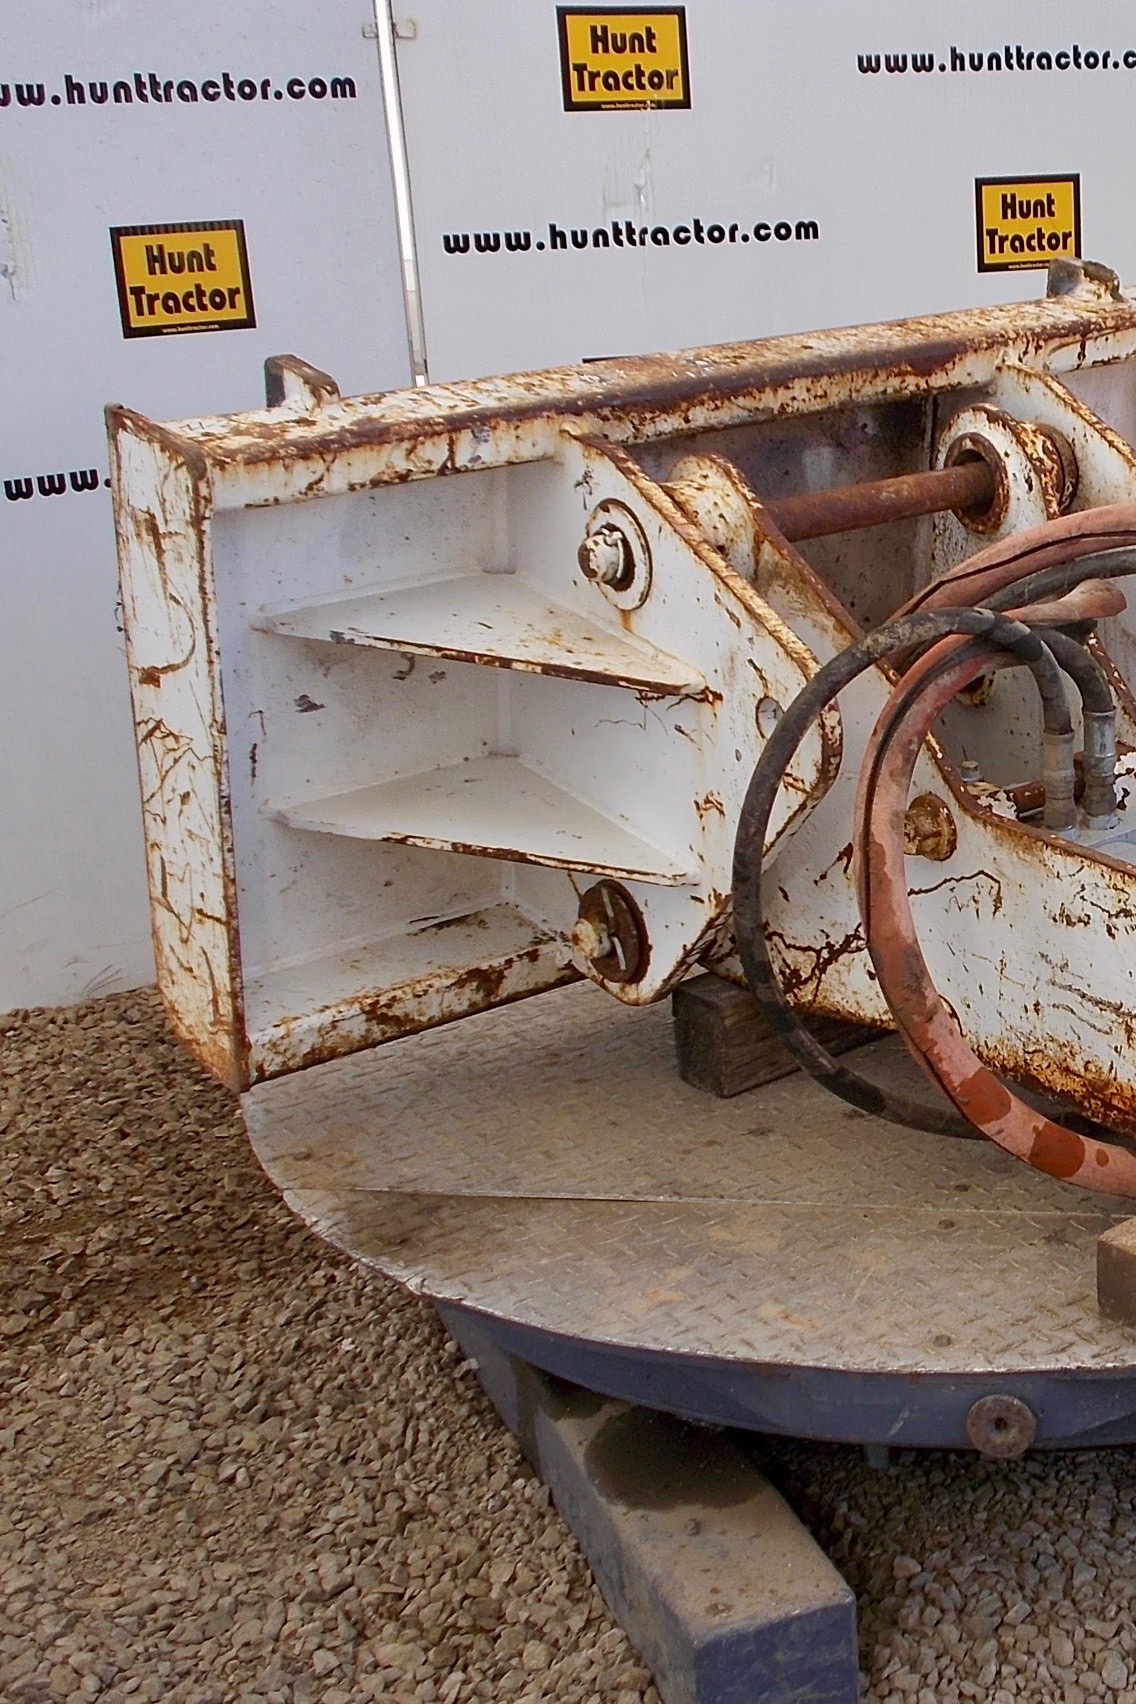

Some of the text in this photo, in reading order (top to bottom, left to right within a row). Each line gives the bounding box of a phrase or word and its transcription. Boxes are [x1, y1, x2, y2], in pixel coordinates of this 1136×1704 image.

[590, 25, 656, 53] Hunt
[572, 62, 679, 92] Tractor
[1002, 193, 1055, 219] Hunt
[443, 219, 818, 254] www.hunttractor.com
[986, 227, 1072, 254] Tractor
[145, 244, 216, 275] Hunt
[129, 285, 240, 316] Tractor
